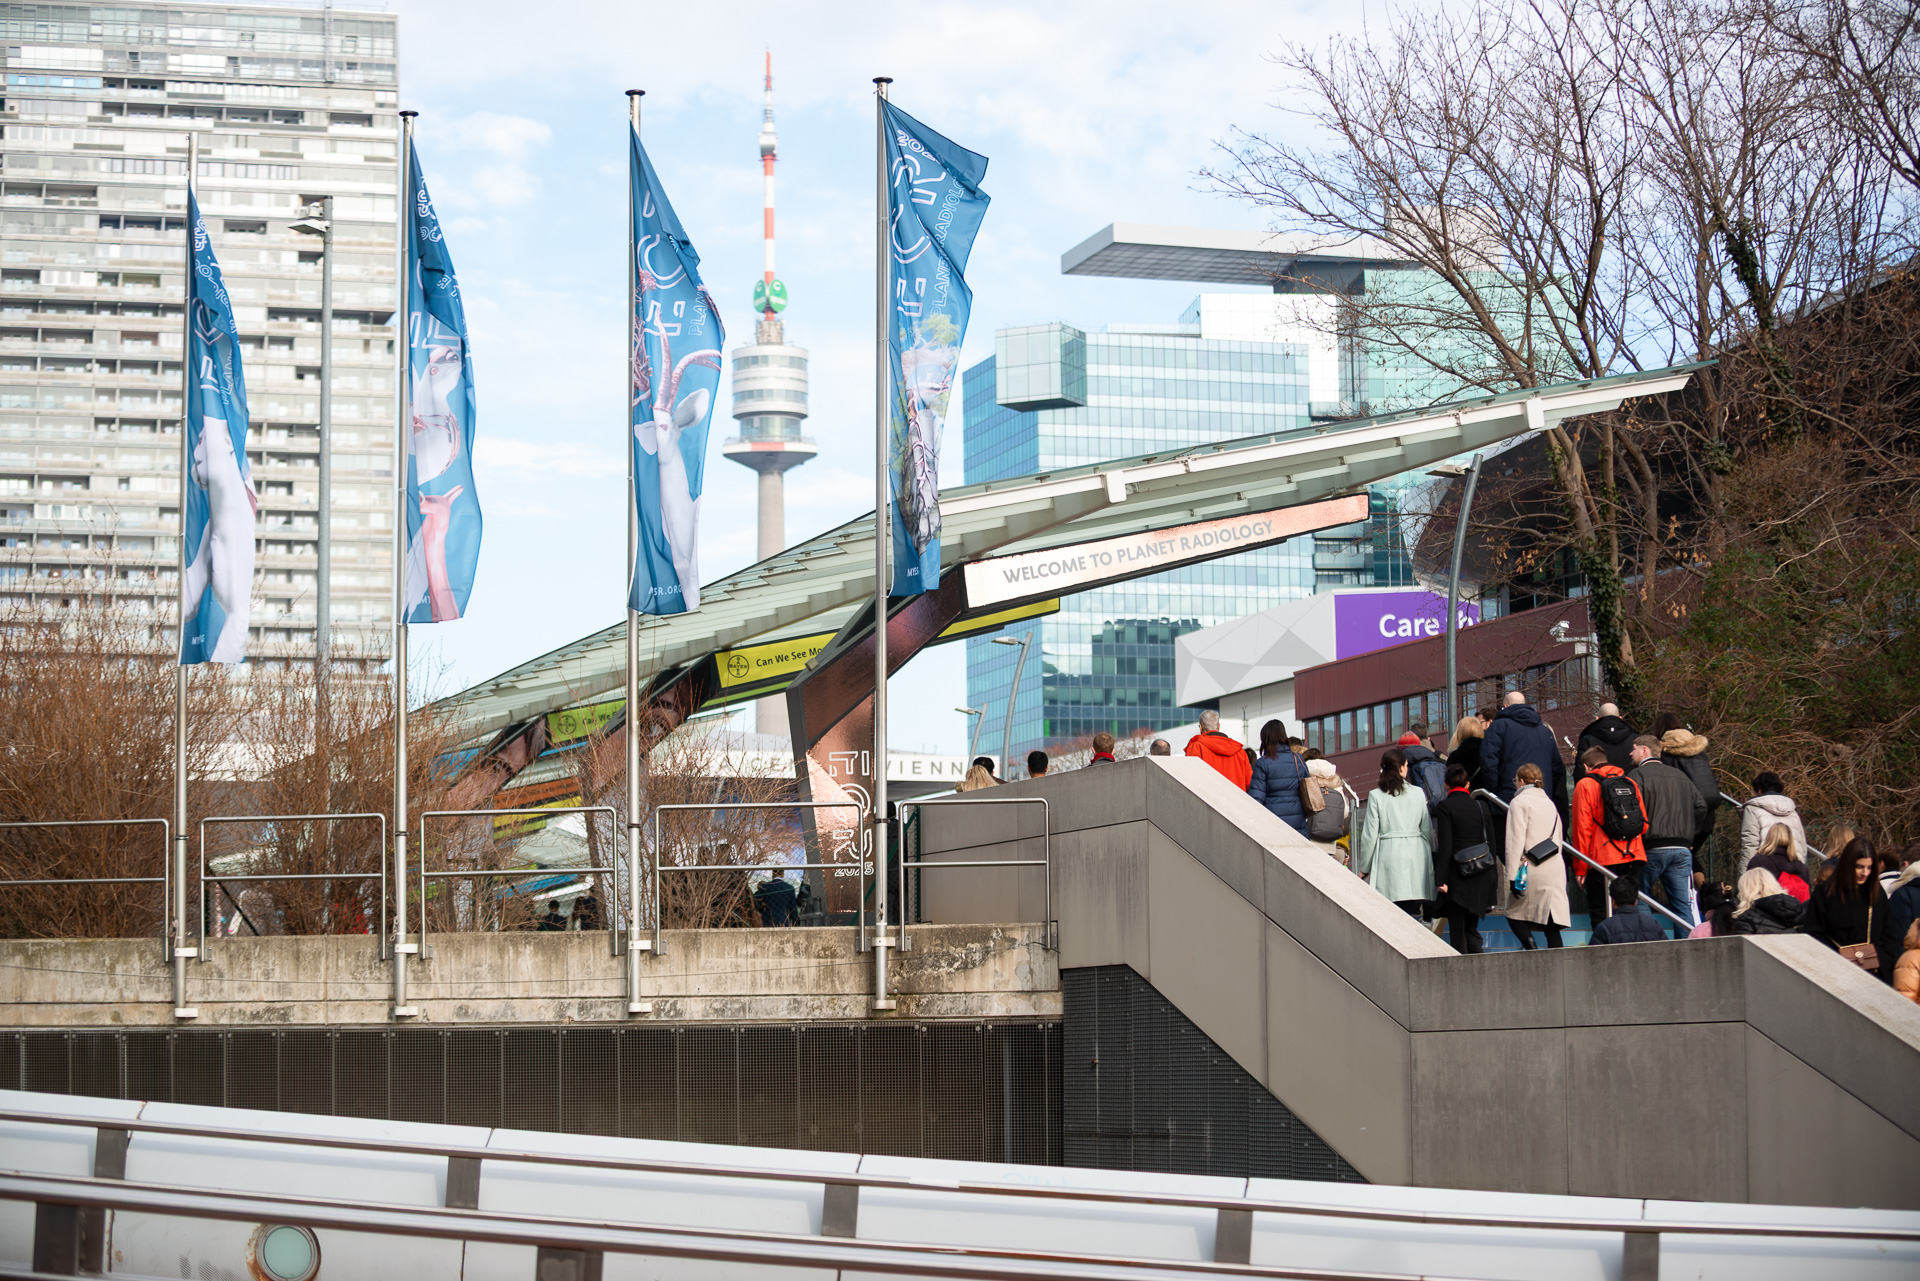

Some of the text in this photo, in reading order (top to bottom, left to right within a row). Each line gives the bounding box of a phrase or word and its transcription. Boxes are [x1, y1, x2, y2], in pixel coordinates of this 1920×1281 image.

[1003, 520, 1273, 584] WELCOME TO PLANET RADIOLOGY
[1379, 613, 1440, 638] Care
[756, 648, 823, 668] Can We See Mo
